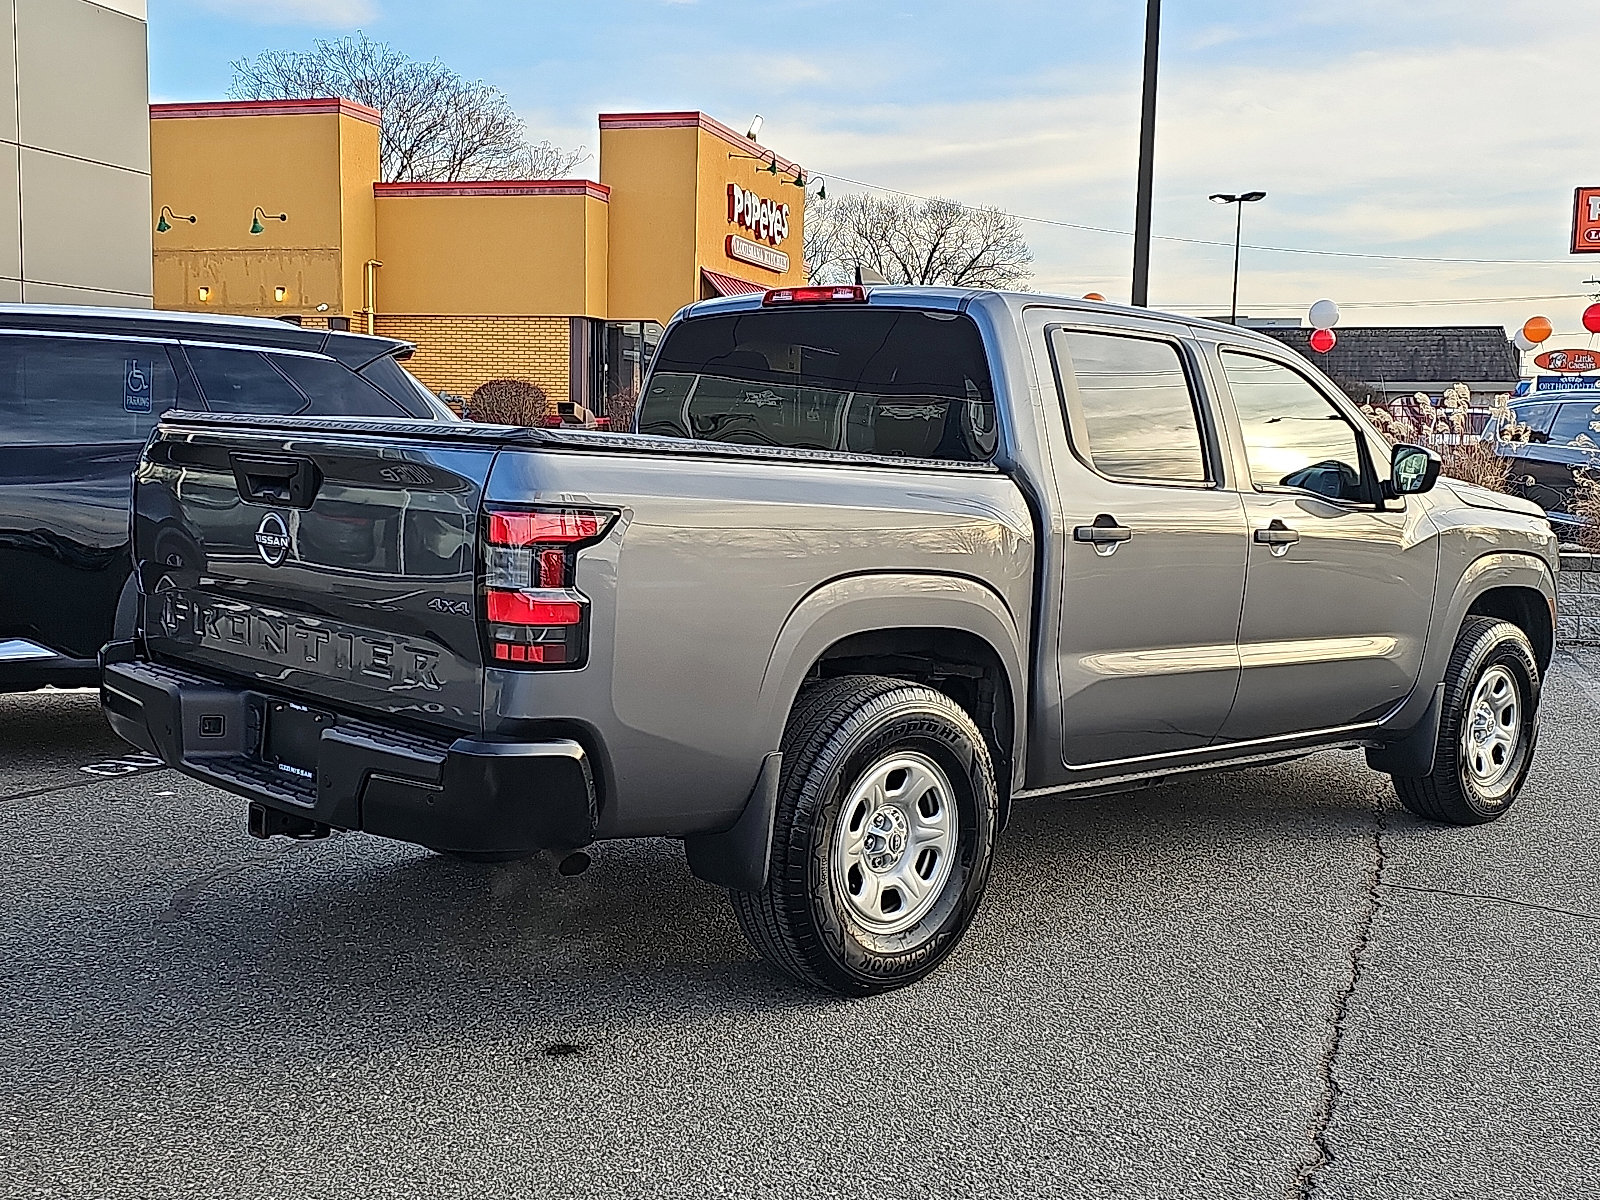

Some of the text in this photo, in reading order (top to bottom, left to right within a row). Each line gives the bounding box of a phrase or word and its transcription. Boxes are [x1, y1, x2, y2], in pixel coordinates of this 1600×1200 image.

[1574, 354, 1595, 363] Little
[1568, 361, 1596, 369] Caesars
[1539, 382, 1598, 391] ORTHODONTI
[127, 395, 150, 408] PARKING
[255, 534, 290, 548] NISSAN
[162, 592, 446, 691] FRONTIER
